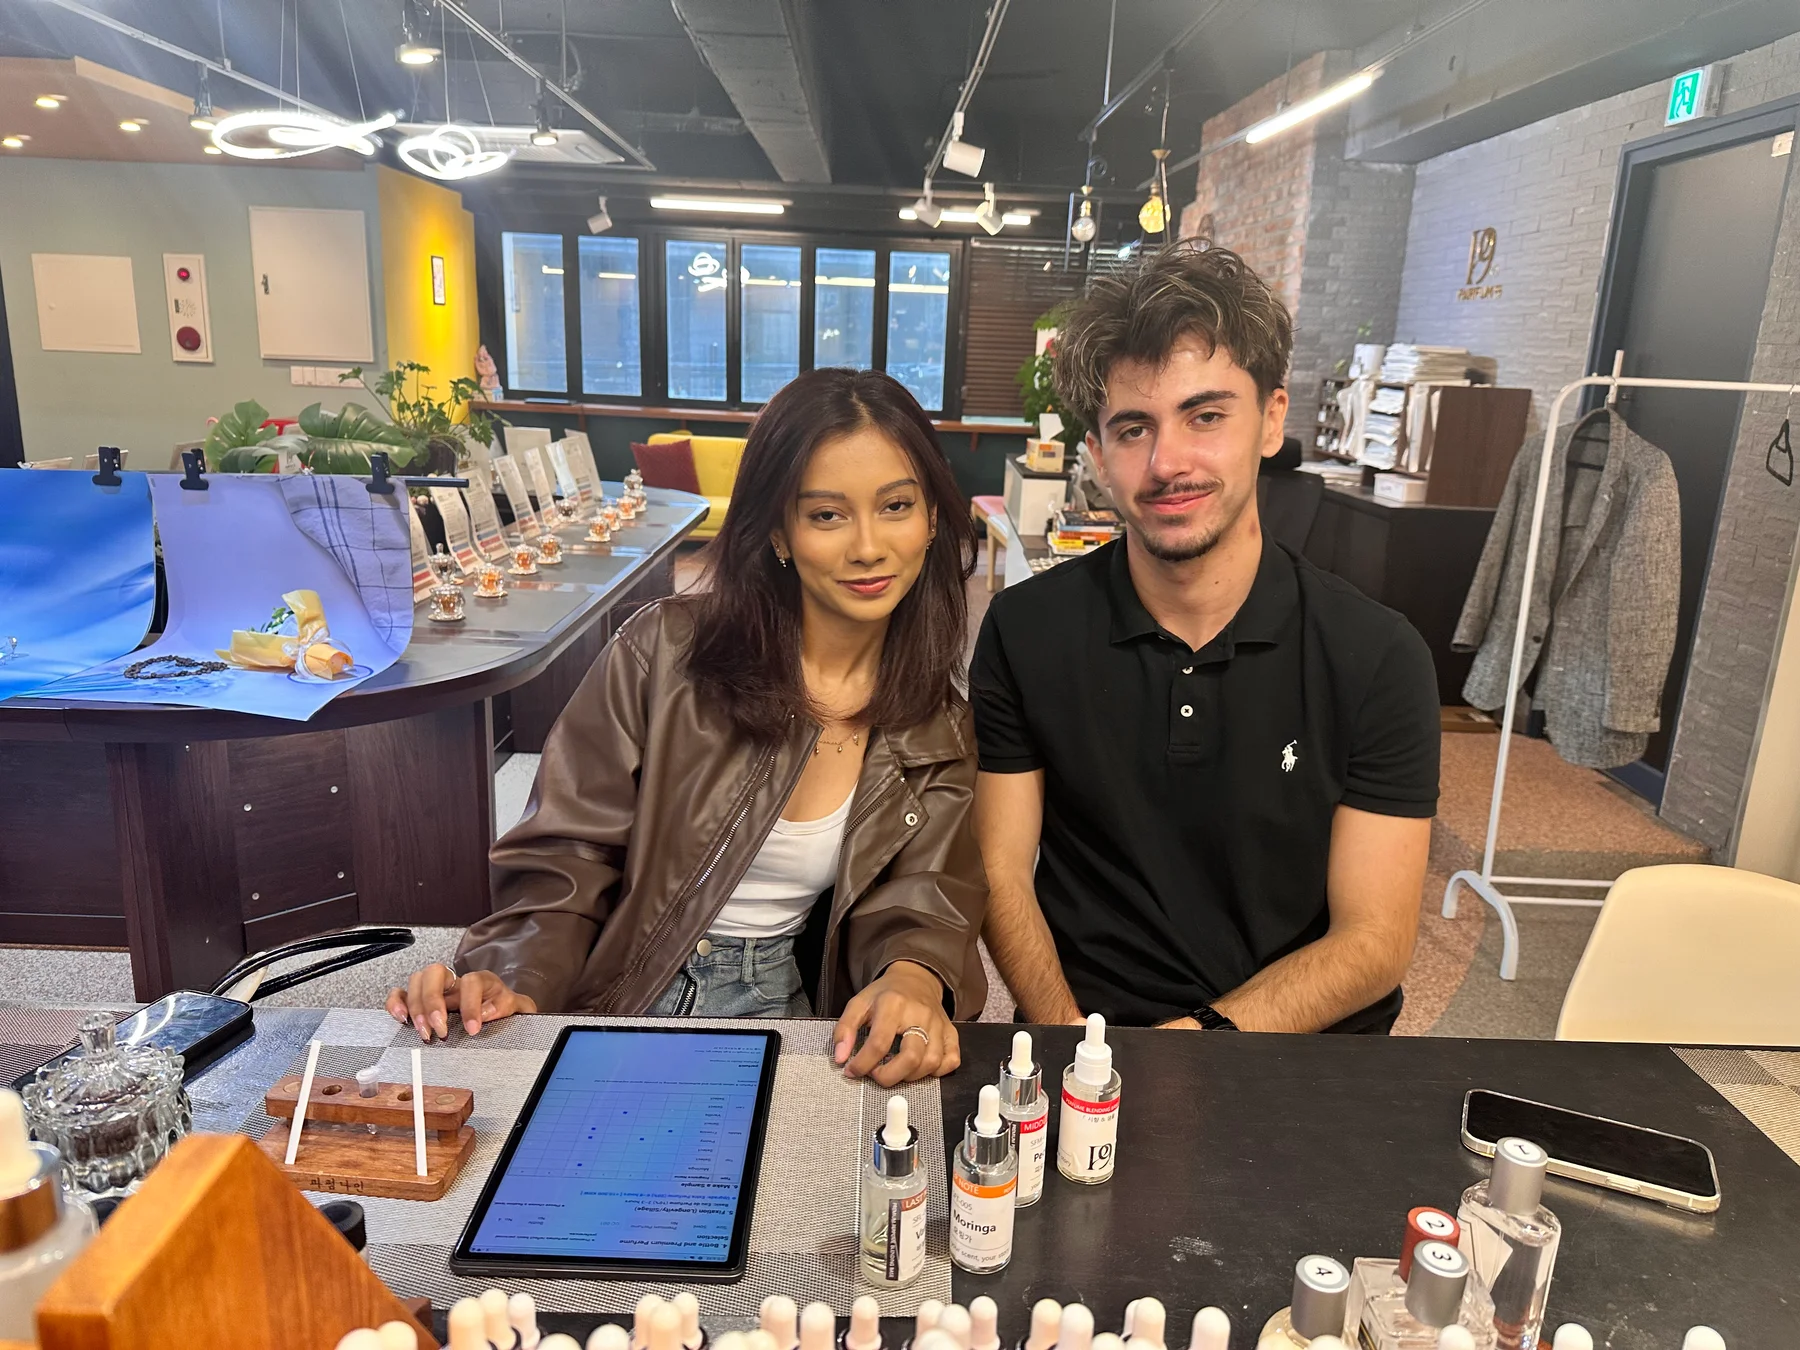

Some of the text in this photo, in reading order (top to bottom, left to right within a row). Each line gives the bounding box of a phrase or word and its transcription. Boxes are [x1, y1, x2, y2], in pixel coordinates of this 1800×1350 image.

[1085, 1106, 1110, 1114] BLENDING
[959, 1178, 979, 1194] NOTE
[905, 1195, 924, 1208] LAST
[633, 1206, 698, 1214] (Longevity/Sillage)
[953, 1209, 997, 1235] Moringa
[1427, 1219, 1445, 1230] 2
[981, 1253, 997, 1263] your
[1432, 1250, 1452, 1262] 3
[1315, 1266, 1333, 1277] 4
